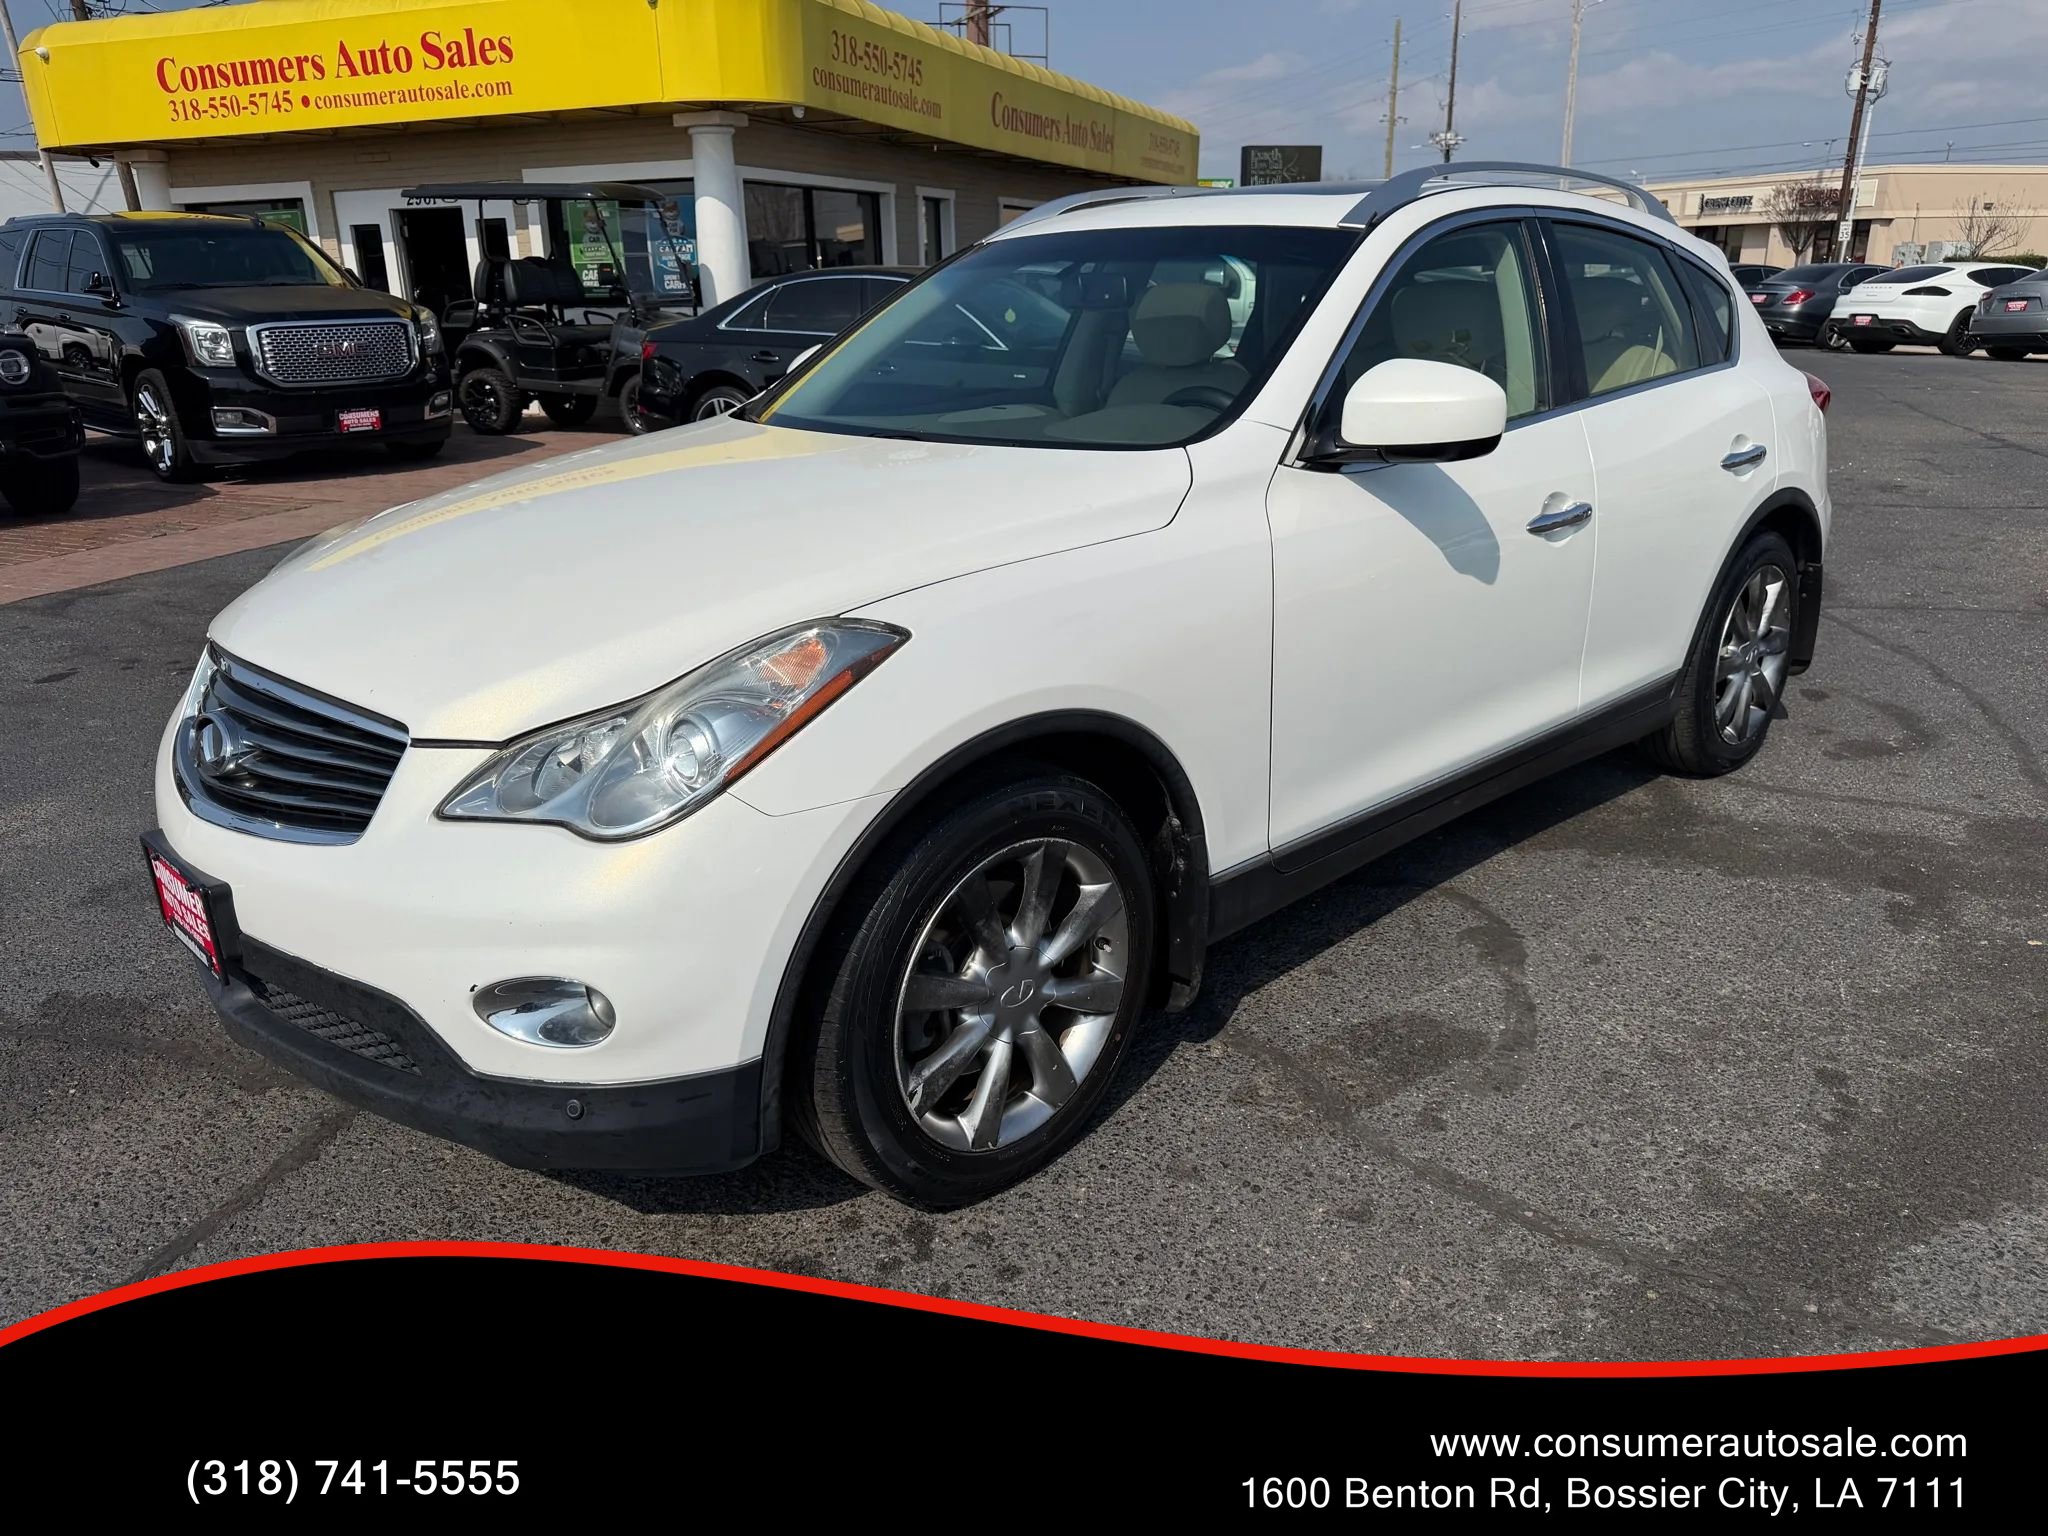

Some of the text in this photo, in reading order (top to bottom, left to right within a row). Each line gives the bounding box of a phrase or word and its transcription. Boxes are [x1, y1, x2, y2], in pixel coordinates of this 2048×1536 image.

[156, 27, 514, 94] Consumers Auto Sales
[831, 30, 923, 87] 318-550-5745
[168, 79, 513, 122] 318-550-5745 consumerautosale.com
[812, 66, 942, 119] consumerautosale.com
[991, 91, 1061, 143] Consumers
[1062, 112, 1088, 149] Auto
[1089, 120, 1115, 154] Sales
[1839, 231, 1850, 239] 35
[317, 340, 369, 358] GMC
[338, 410, 380, 420] CONSUMERS
[181, 905, 211, 942] SALES
